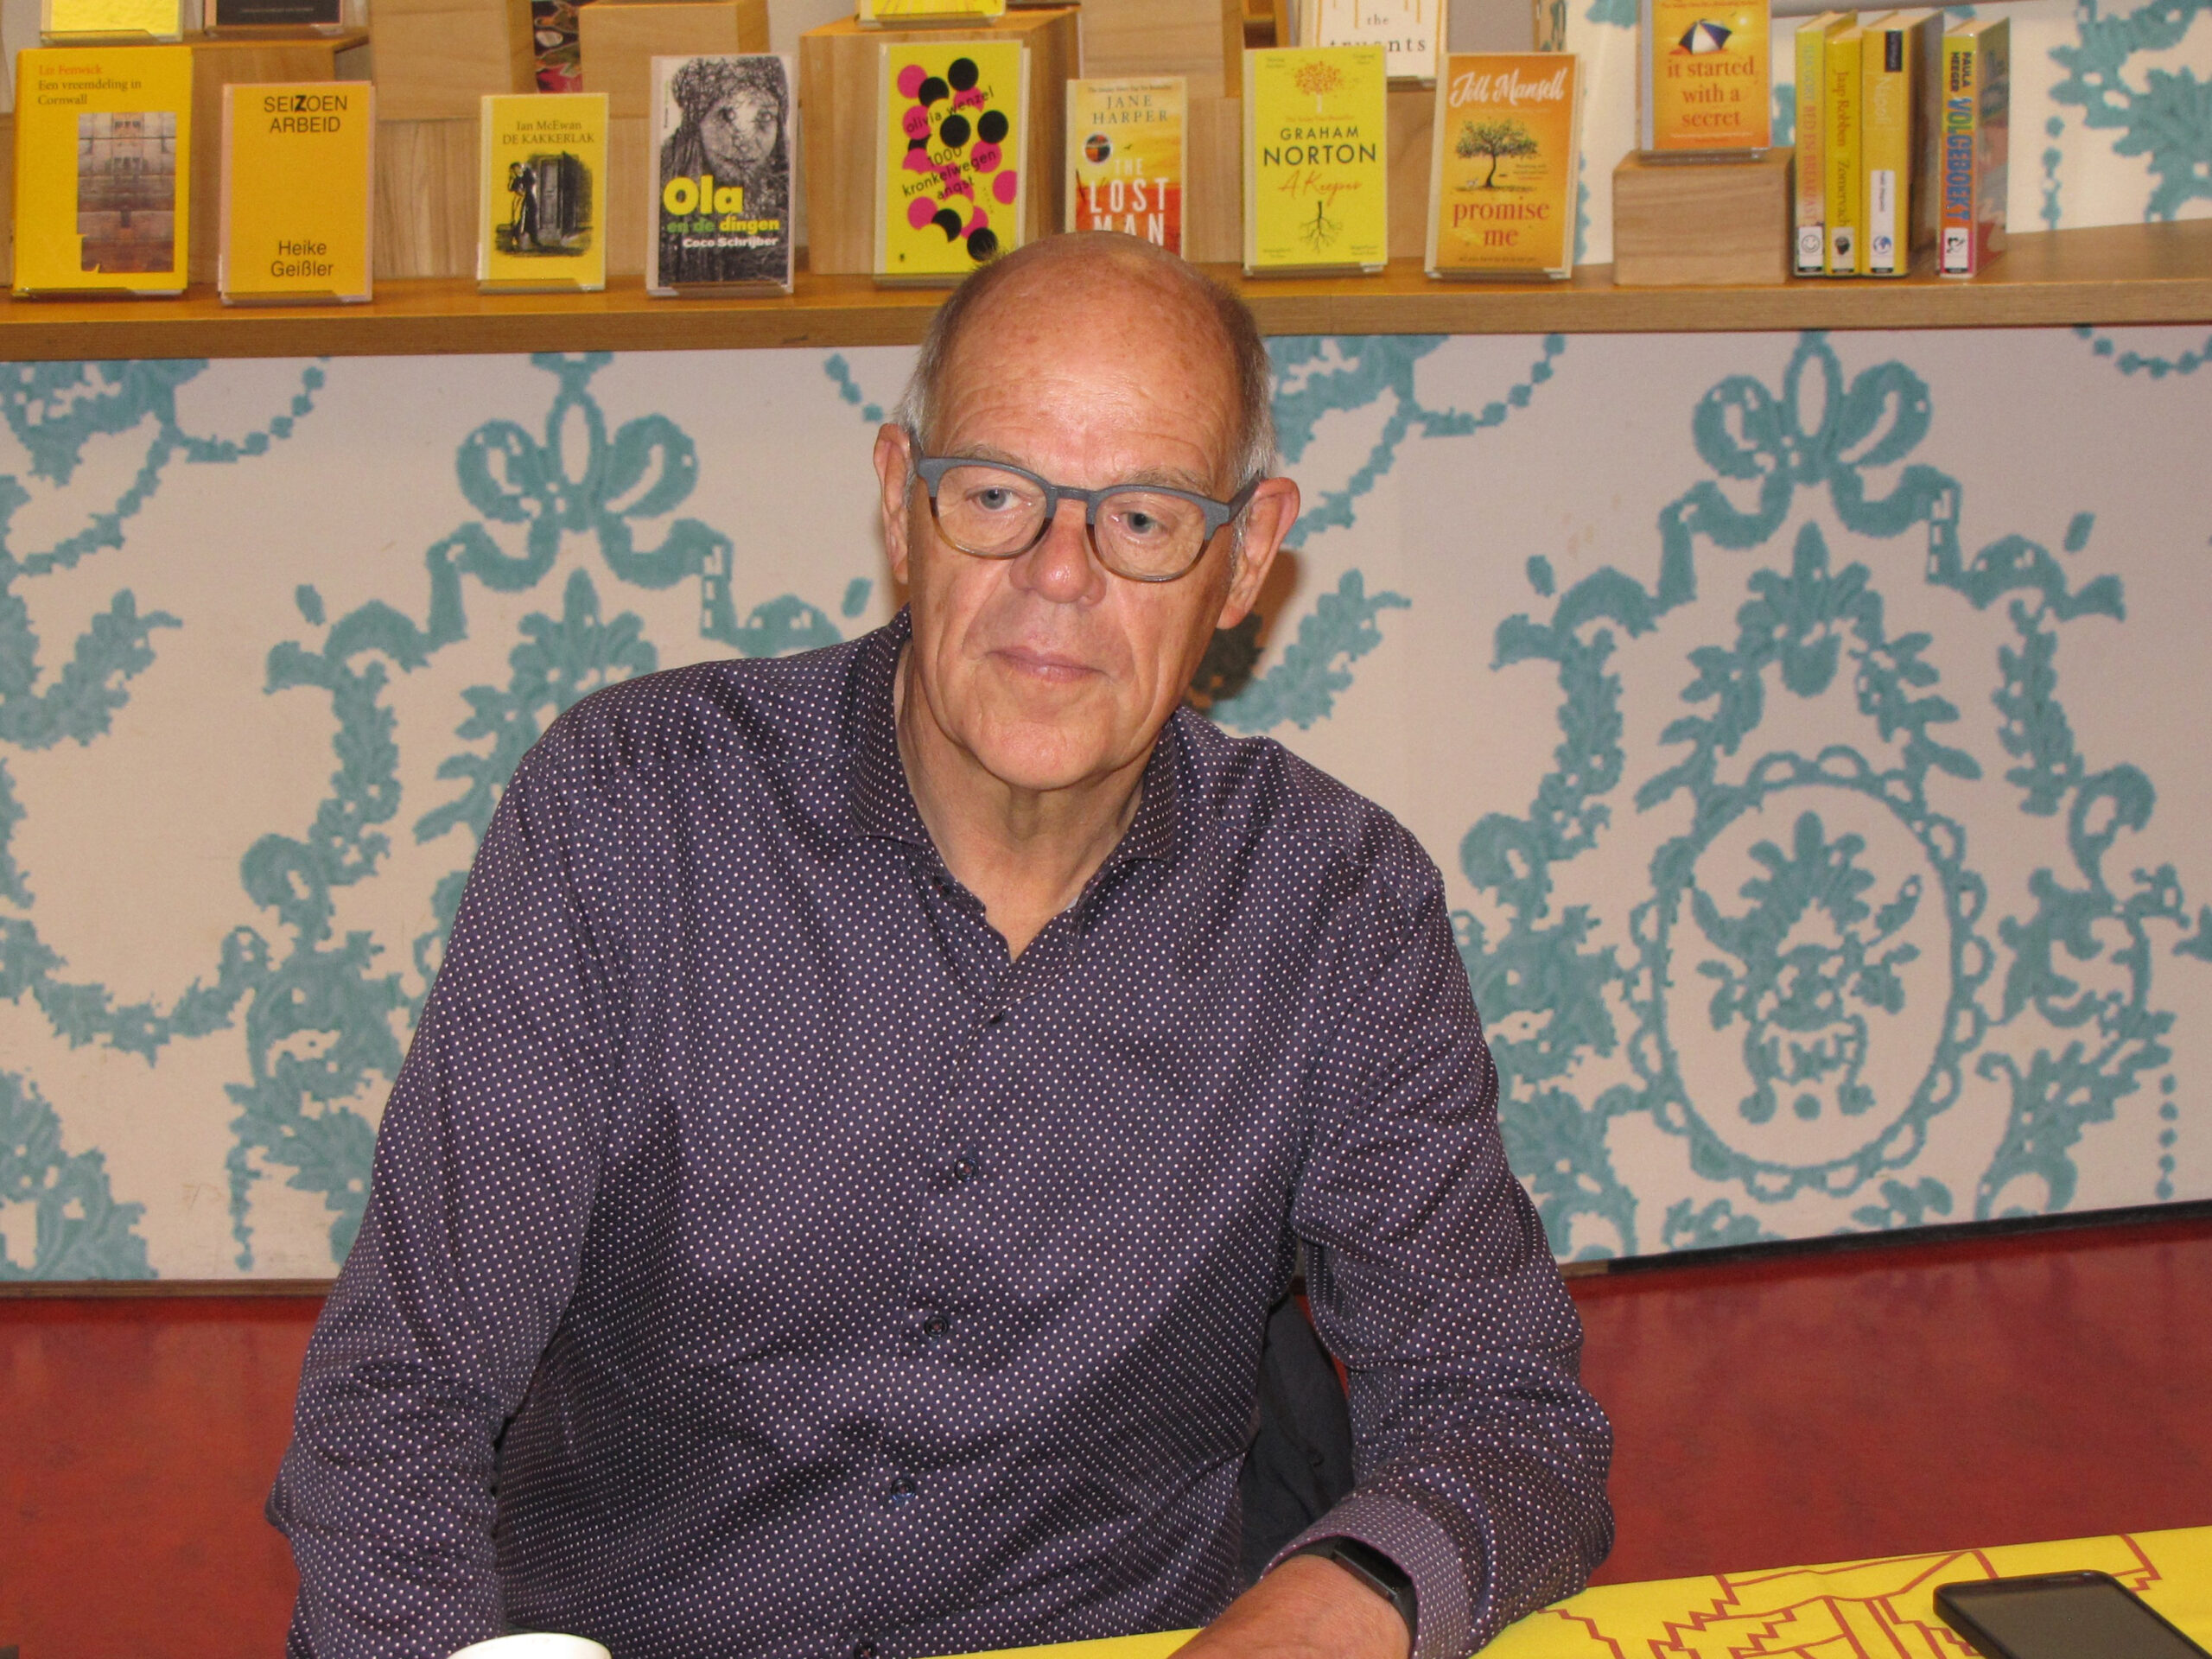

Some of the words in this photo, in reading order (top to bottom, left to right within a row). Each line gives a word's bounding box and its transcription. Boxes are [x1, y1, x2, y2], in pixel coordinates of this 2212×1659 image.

[1367, 14, 1389, 25] the
[58, 64, 103, 75] Fenwick
[1667, 59, 1681, 79] it
[1688, 55, 1755, 78] started
[1961, 52, 1973, 87] PAULA
[38, 80, 59, 91] Een
[61, 79, 129, 92] vreemdeling
[130, 79, 142, 89] in
[1449, 71, 1491, 108] Jill
[1492, 67, 1568, 106] Mansell
[1682, 83, 1724, 104] with
[1730, 88, 1741, 103] a
[1832, 72, 1849, 98] Jaap
[37, 94, 88, 105] Cornwall
[264, 95, 348, 113] SEIZOEN
[906, 111, 943, 133] olivia
[946, 85, 995, 114] wenzel
[1107, 94, 1153, 110] JANE
[270, 116, 341, 133] ARBEID
[517, 121, 533, 130] Ian
[537, 120, 582, 130] McEwan
[1092, 110, 1167, 124] HARPER
[1681, 111, 1741, 127] secret
[1804, 105, 1817, 130] BED
[1837, 100, 1851, 148] Robben
[502, 134, 519, 145] DE
[522, 132, 595, 144] KAKKERLAK
[1280, 125, 1359, 141] GRAHAM
[1804, 133, 1816, 152] EN
[927, 147, 963, 167] 1000
[1263, 143, 1376, 167] NORTON
[902, 150, 996, 197] kronkelwegen
[1114, 158, 1144, 176] THE
[663, 175, 744, 216] Ola
[937, 176, 975, 200] angst
[1090, 176, 1171, 213] LOST
[1277, 168, 1300, 200] A
[1302, 170, 1363, 207] Keeper
[1804, 155, 1817, 219] BREAKFAST
[1838, 159, 1851, 226] Zomervach
[1452, 196, 1551, 228] promise
[666, 221, 690, 233] en
[693, 217, 715, 232] de
[719, 215, 780, 235] dingen
[1093, 213, 1165, 246] MAN
[278, 239, 327, 256] Heike
[682, 238, 715, 249] Coco
[717, 236, 779, 249] Schrijber
[1484, 229, 1519, 247] me
[270, 260, 334, 277] Geißler
